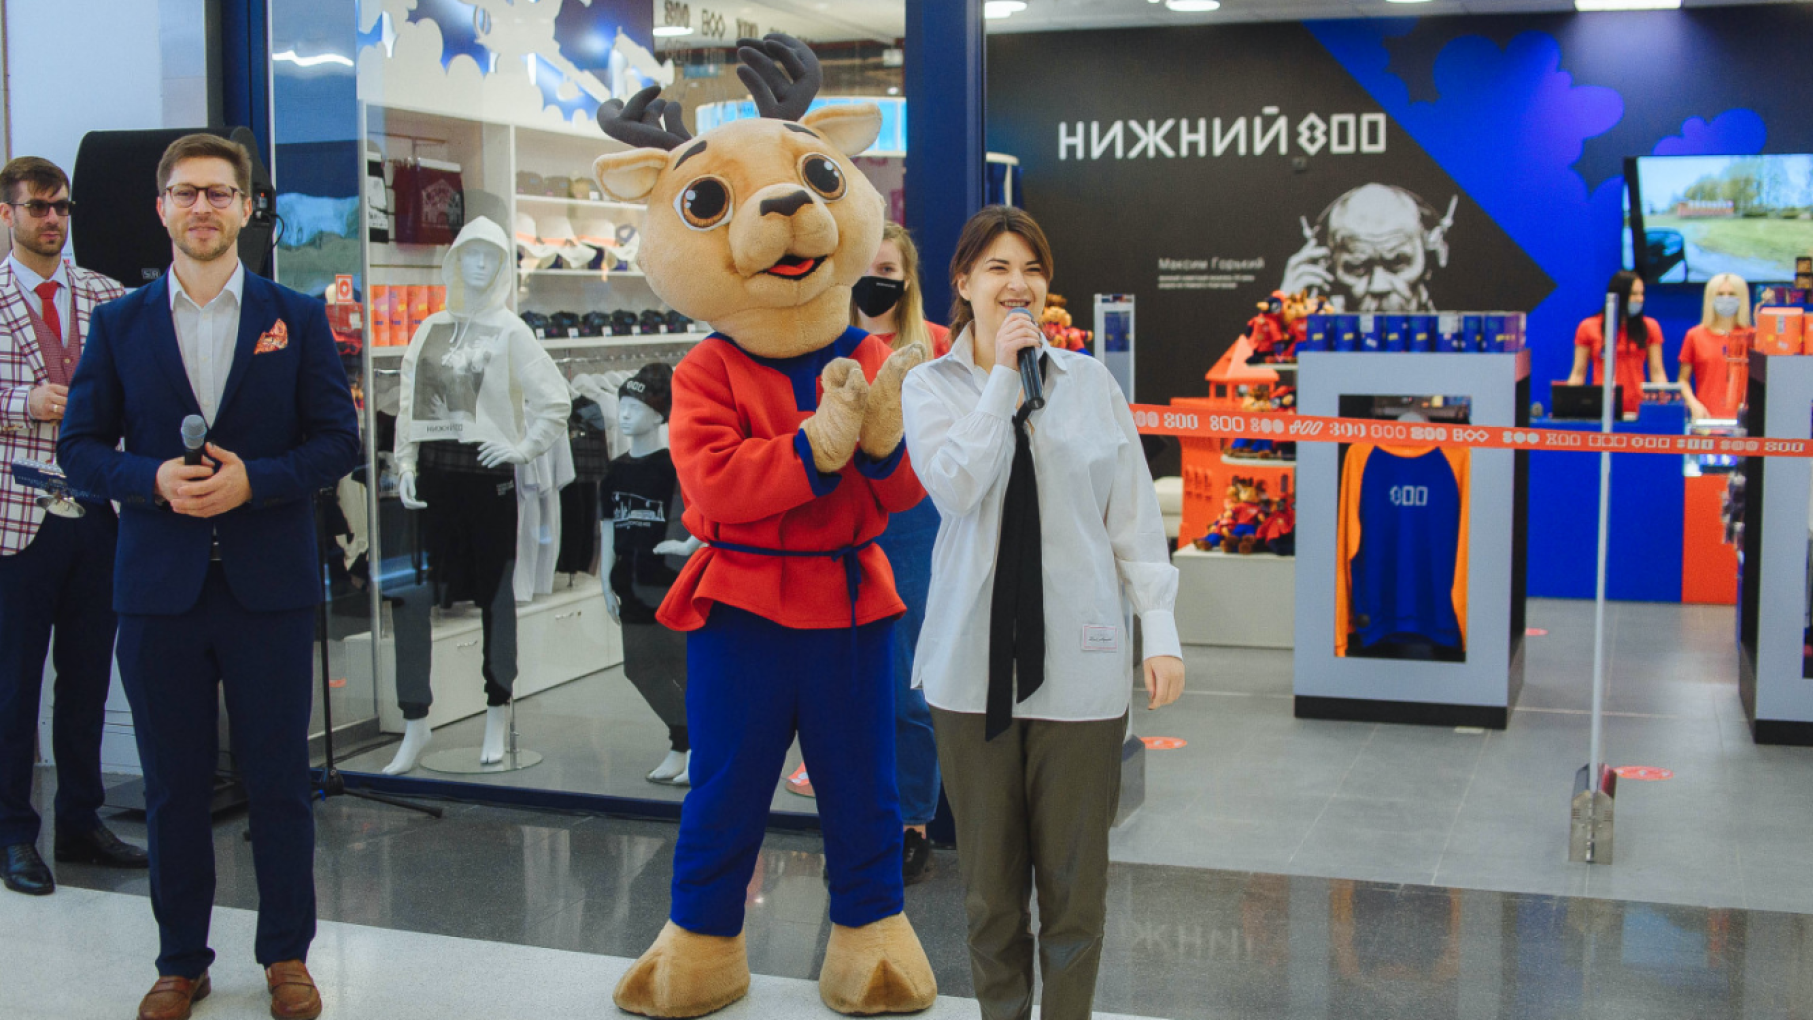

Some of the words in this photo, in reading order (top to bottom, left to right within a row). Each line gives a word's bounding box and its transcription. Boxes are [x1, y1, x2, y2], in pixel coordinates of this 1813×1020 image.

[1058, 106, 1289, 161] НИЖНИЙ
[1163, 411, 1199, 430] 800
[1209, 414, 1245, 432] 800
[1250, 417, 1285, 434] 800
